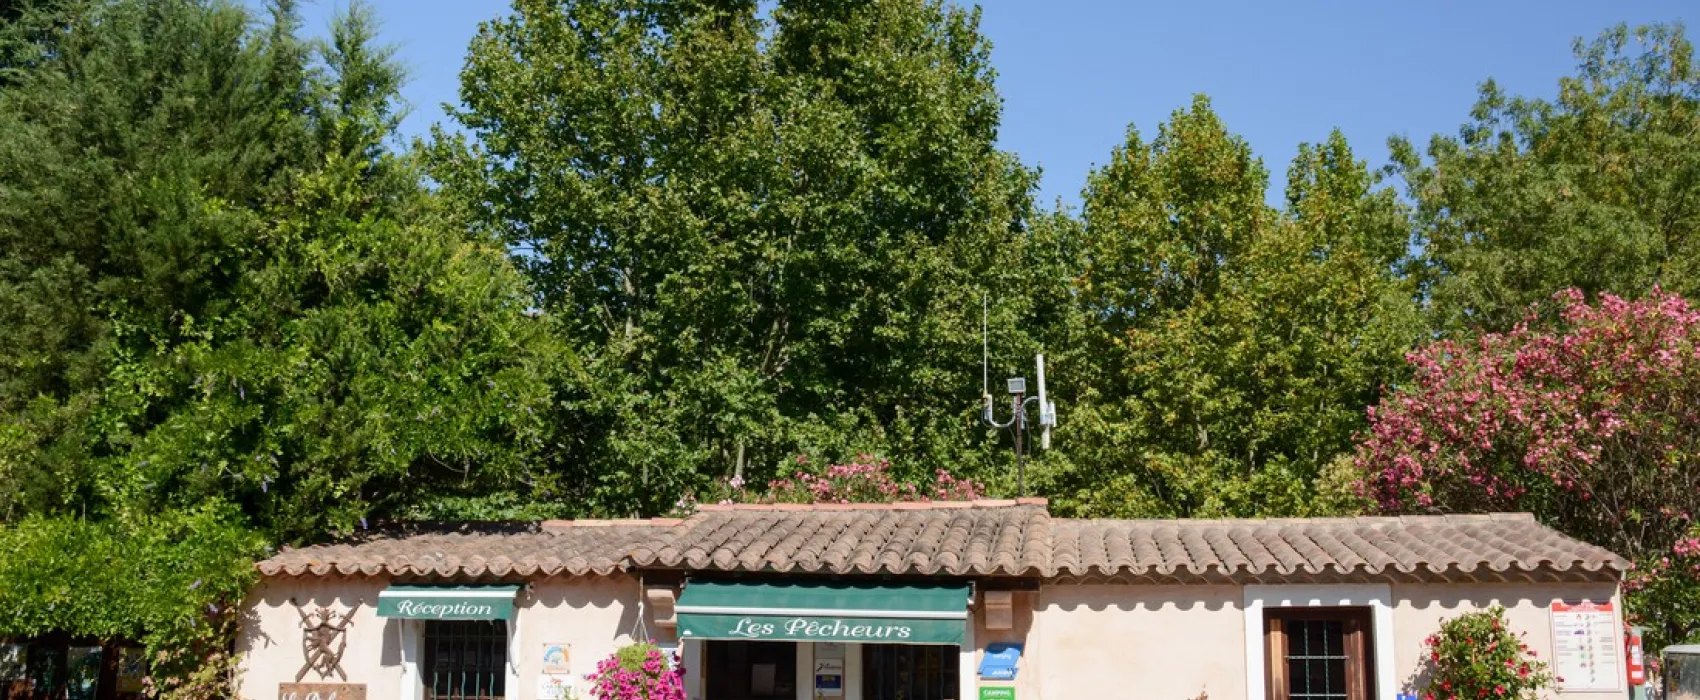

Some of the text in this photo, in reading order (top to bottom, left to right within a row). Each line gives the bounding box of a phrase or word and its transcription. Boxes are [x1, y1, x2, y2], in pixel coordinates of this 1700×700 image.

[396, 599, 492, 618] Réception
[728, 617, 912, 638] Les Pêcheurs
